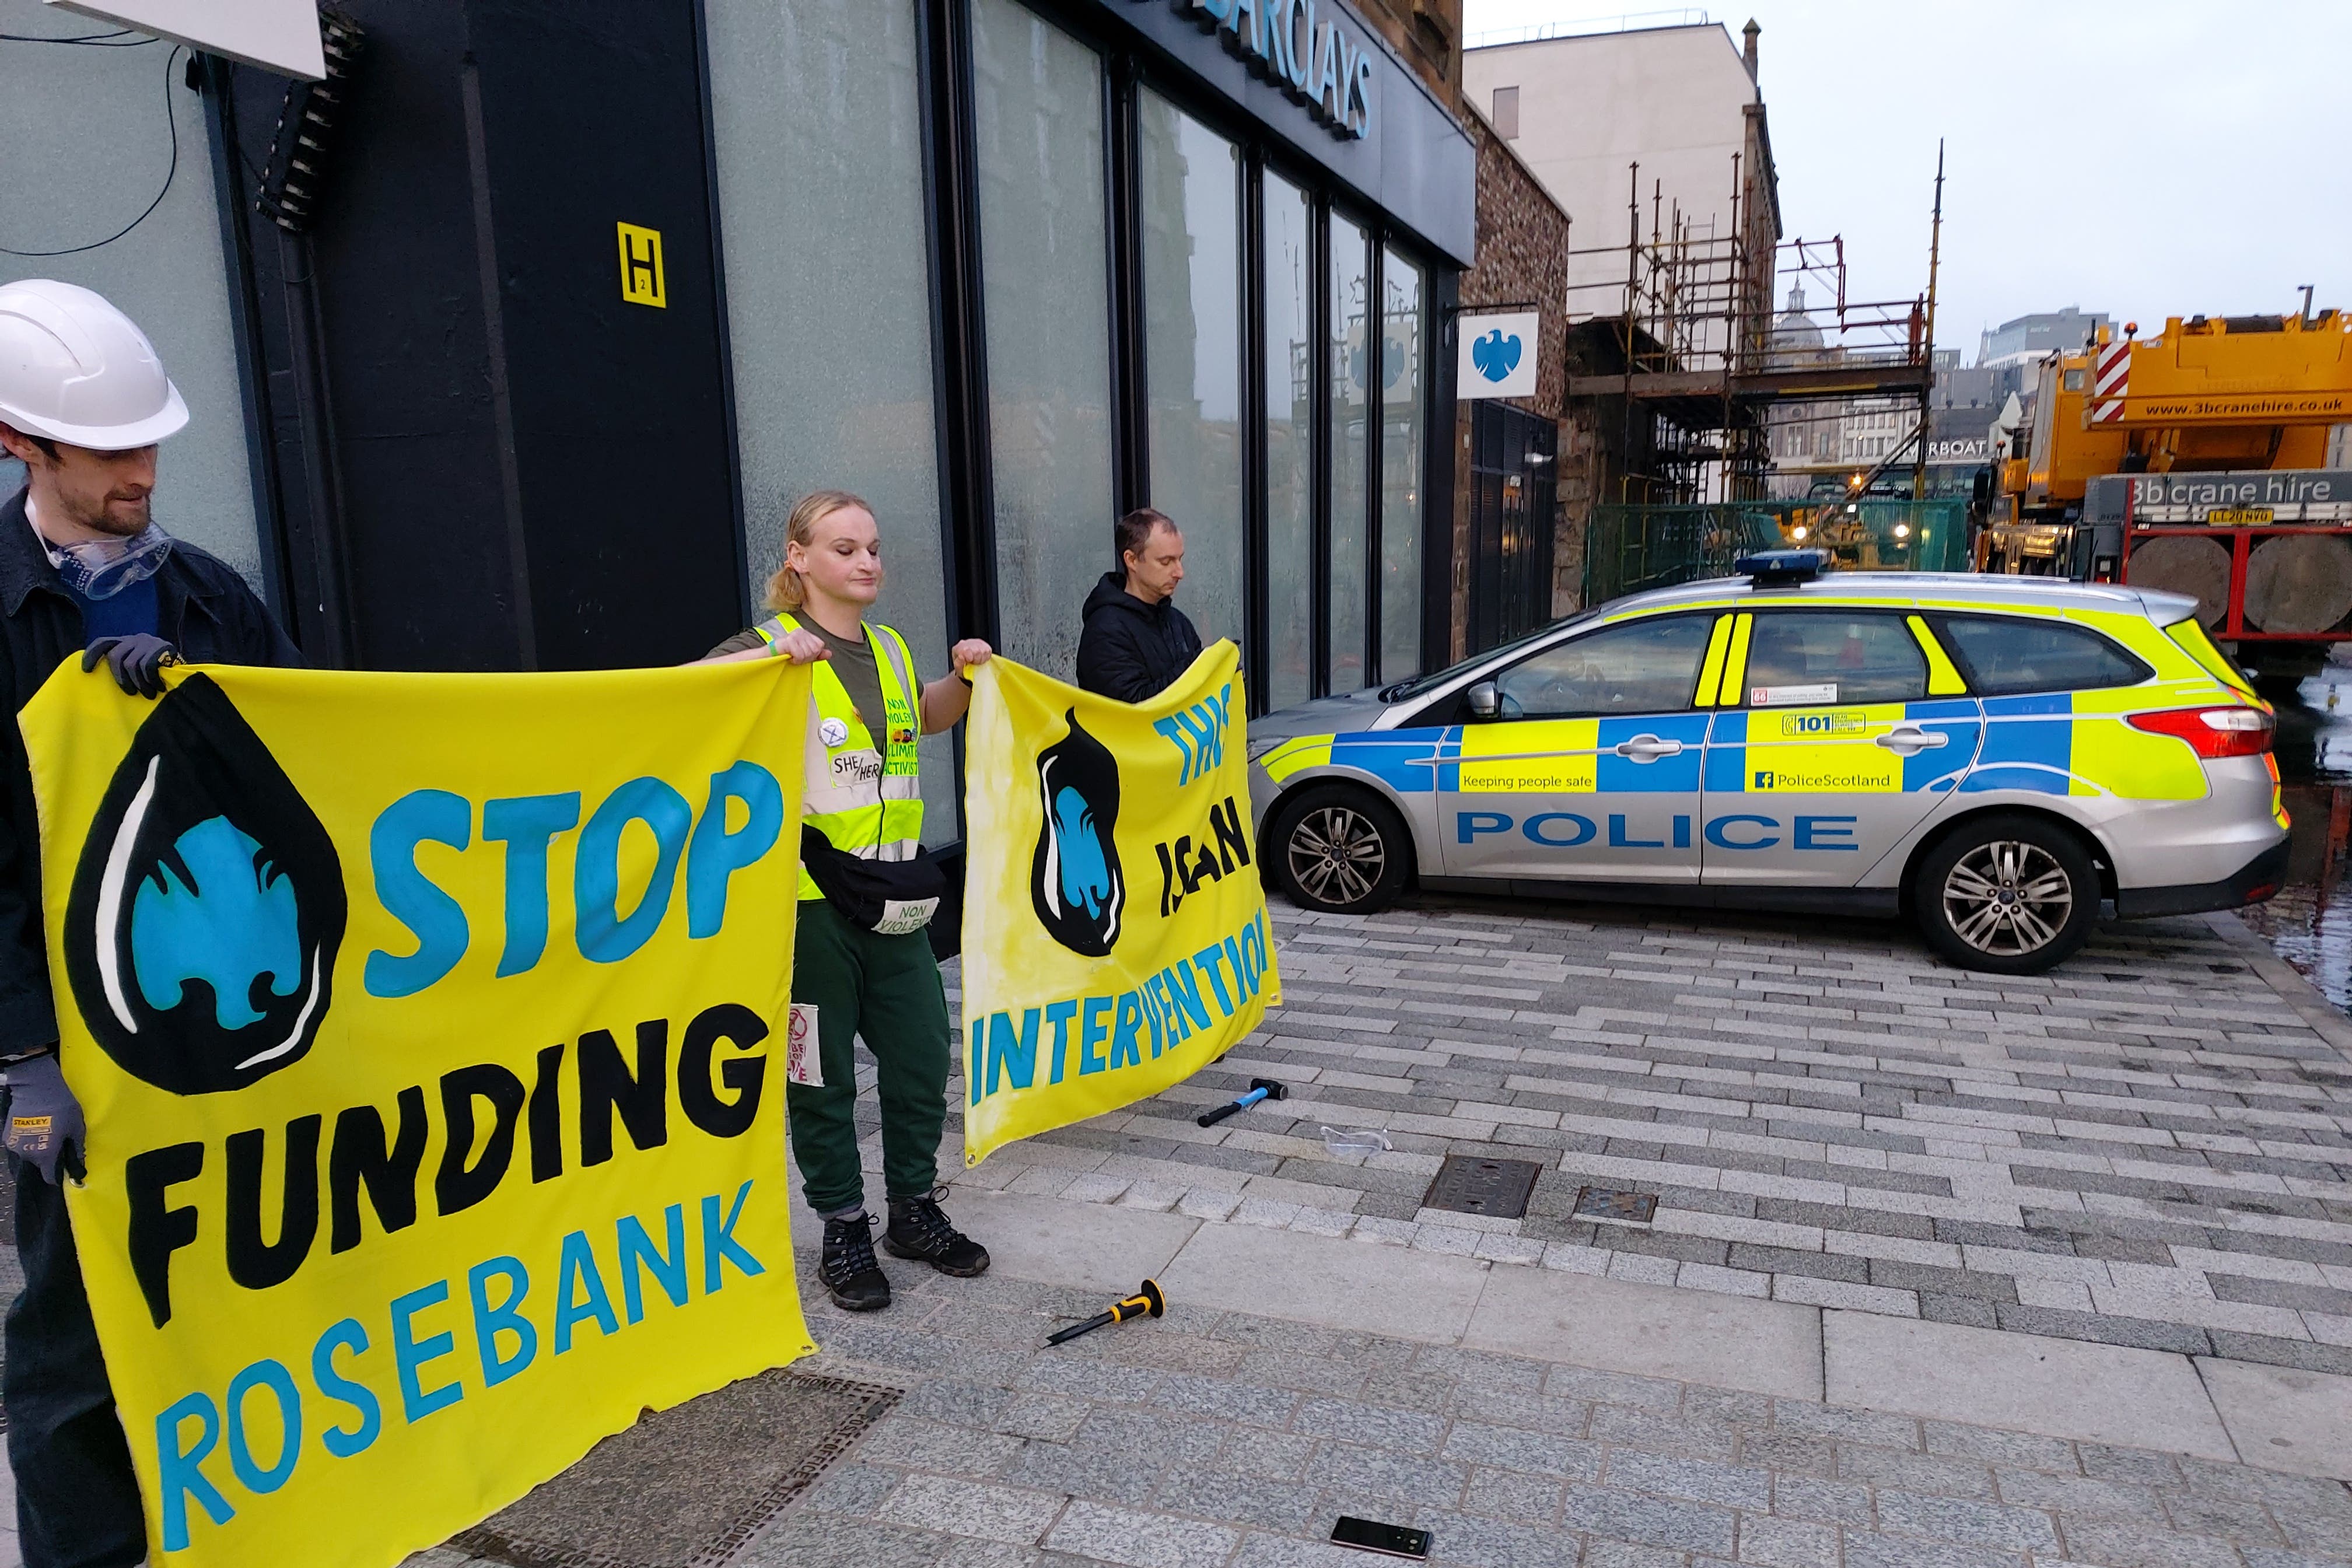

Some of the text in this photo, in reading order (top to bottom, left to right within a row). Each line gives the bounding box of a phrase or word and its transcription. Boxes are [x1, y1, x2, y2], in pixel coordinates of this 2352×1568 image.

[1204, 0, 1371, 139] RCLAYS
[625, 233, 657, 297] H
[640, 279, 645, 289] 2
[2146, 398, 2343, 415] www.3bcranehire.co.uk
[2171, 483, 2257, 503] crane
[2266, 476, 2331, 502] hire
[1798, 716, 1830, 732] 101
[834, 755, 879, 781] SHE/HER
[1779, 774, 1891, 788] PoliceScotland
[1463, 775, 1592, 790] Keeping people safe
[1457, 811, 1859, 850] POLICE
[365, 760, 783, 998] STOP
[898, 905, 928, 919] NON
[125, 1003, 769, 1329] FUNDING
[156, 1180, 765, 1551] ROSEBANK
[709, 1413, 868, 1558] POST OFFICE TELEPHONES
